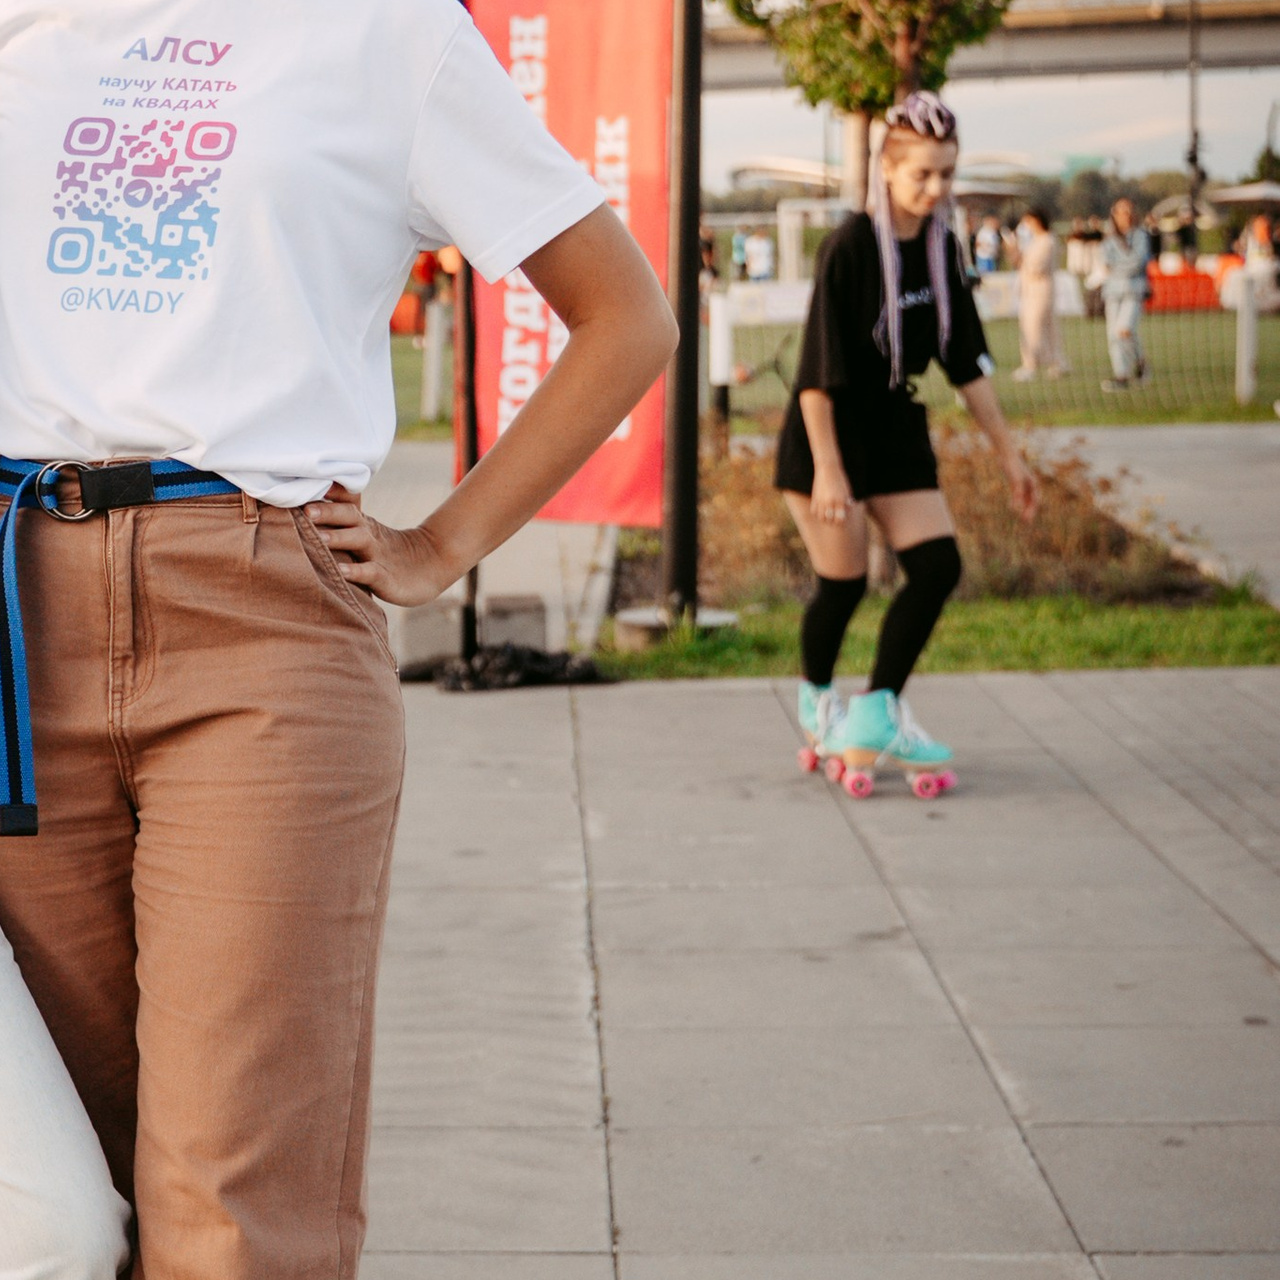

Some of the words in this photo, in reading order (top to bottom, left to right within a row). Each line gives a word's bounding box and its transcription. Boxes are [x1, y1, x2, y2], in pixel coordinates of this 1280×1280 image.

[122, 36, 233, 67] АЛСУ
[98, 76, 157, 92] научу
[162, 77, 238, 93] КАТАТЬ
[102, 97, 126, 108] на
[132, 97, 220, 112] КВАДАХ
[60, 286, 185, 314] @KVADY
